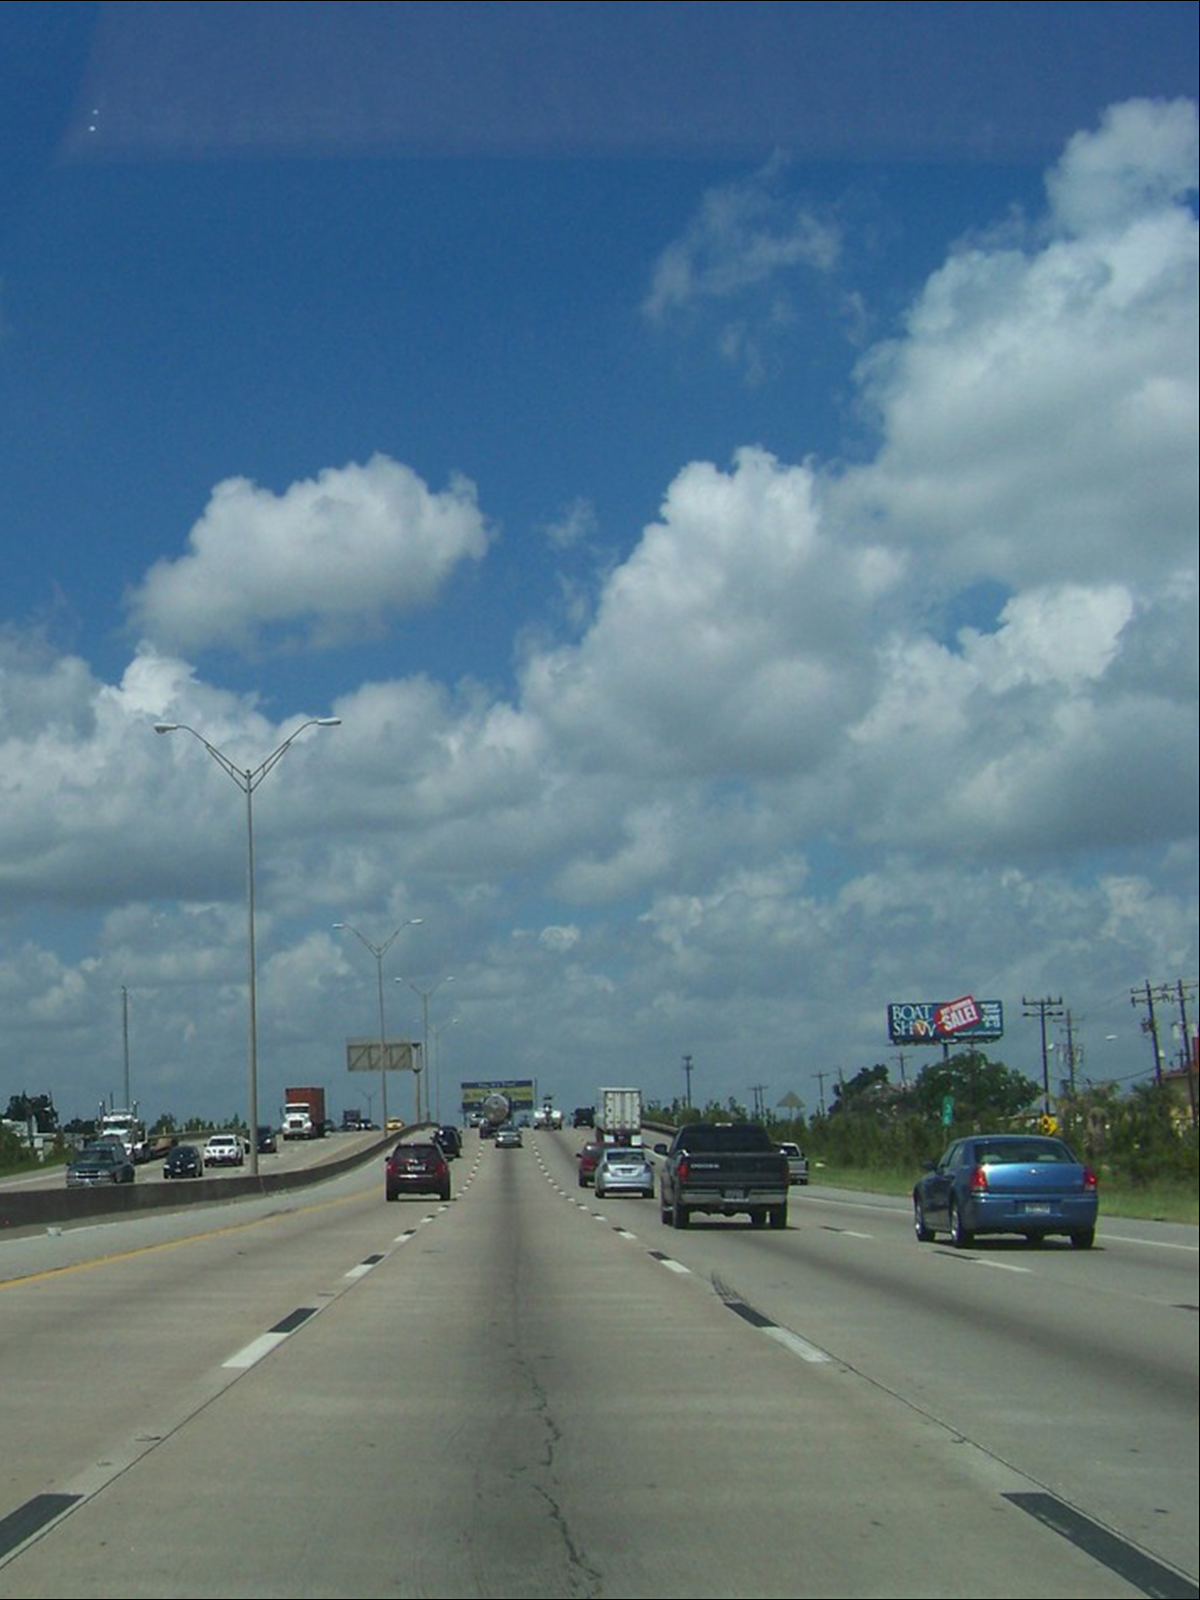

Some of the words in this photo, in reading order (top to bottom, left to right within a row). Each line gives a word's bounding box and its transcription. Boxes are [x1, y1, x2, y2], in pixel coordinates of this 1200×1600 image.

[892, 1005, 932, 1020] BOAT
[941, 1003, 978, 1031] SALE!
[893, 1020, 936, 1036] SHOW
